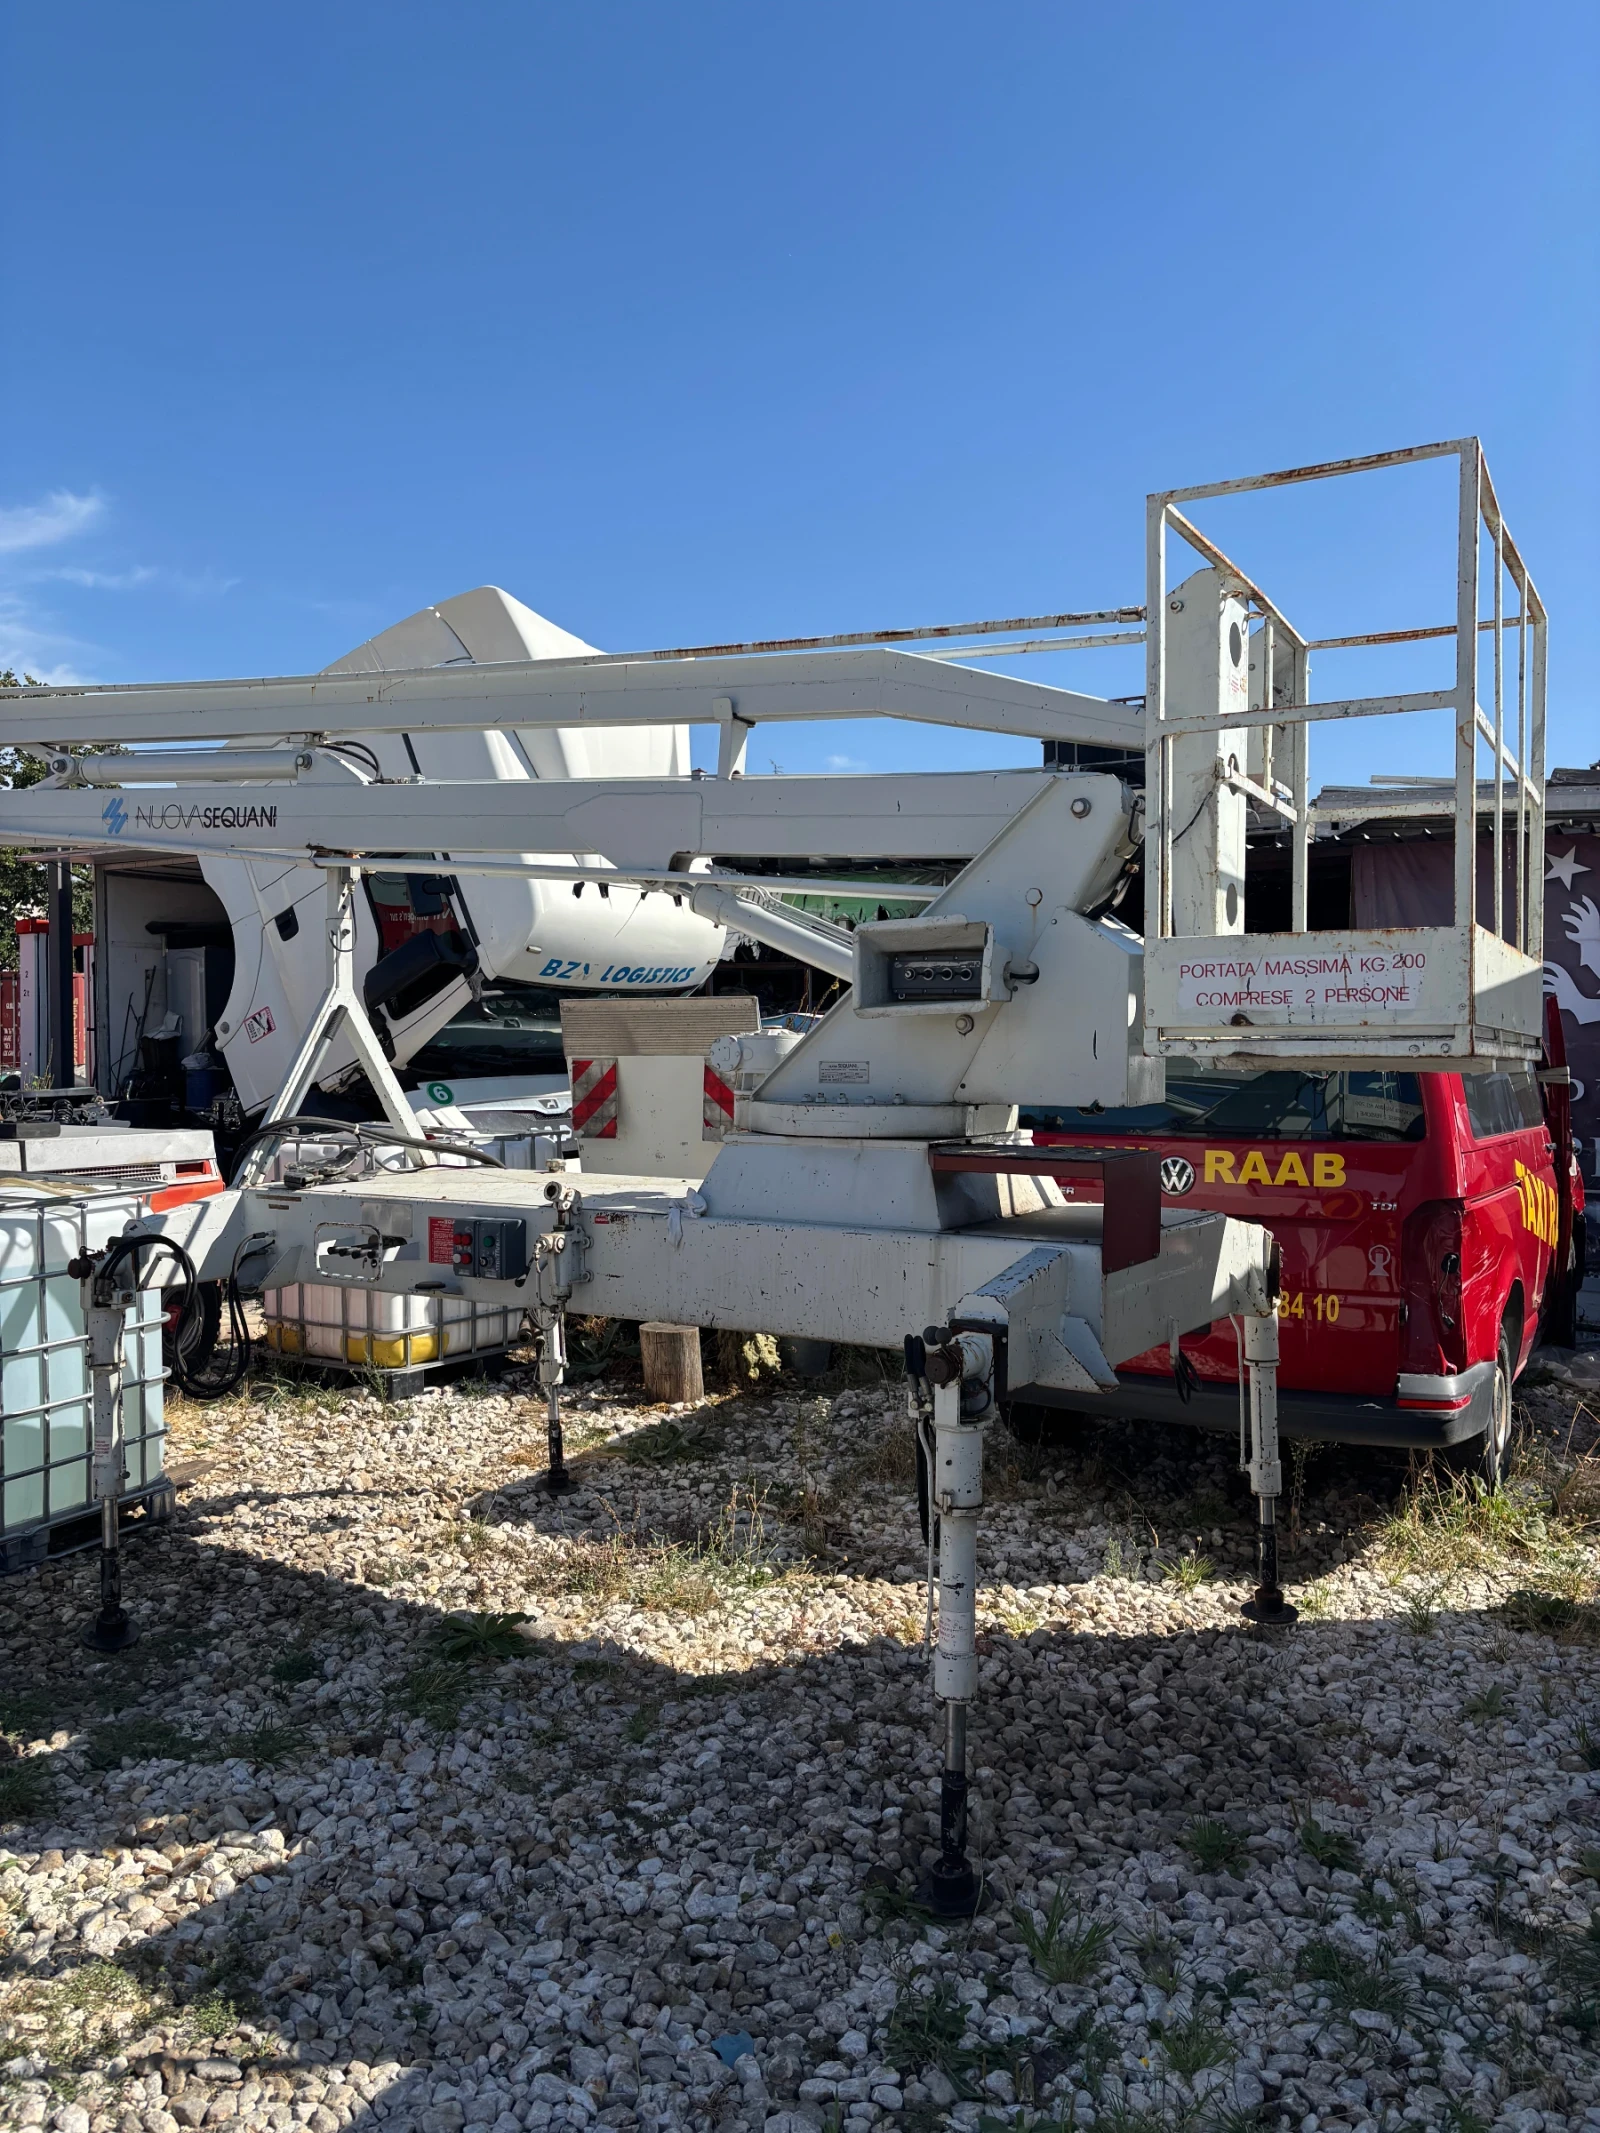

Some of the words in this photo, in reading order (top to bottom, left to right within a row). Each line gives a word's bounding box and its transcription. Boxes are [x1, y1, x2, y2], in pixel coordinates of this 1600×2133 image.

[600, 965, 697, 984] LOGISTICS
[1180, 962, 1256, 978] PORTATA
[1265, 958, 1352, 976] MASSIMA
[1392, 953, 1426, 969] 200
[1196, 989, 1294, 1007] COMPRESE
[1305, 989, 1316, 1004] 2
[1324, 986, 1410, 1003] PERSONE
[432, 1085, 449, 1101] 6
[1203, 1149, 1347, 1188] RAAB
[1370, 1202, 1398, 1211] TDI
[1313, 1293, 1340, 1323] 10
